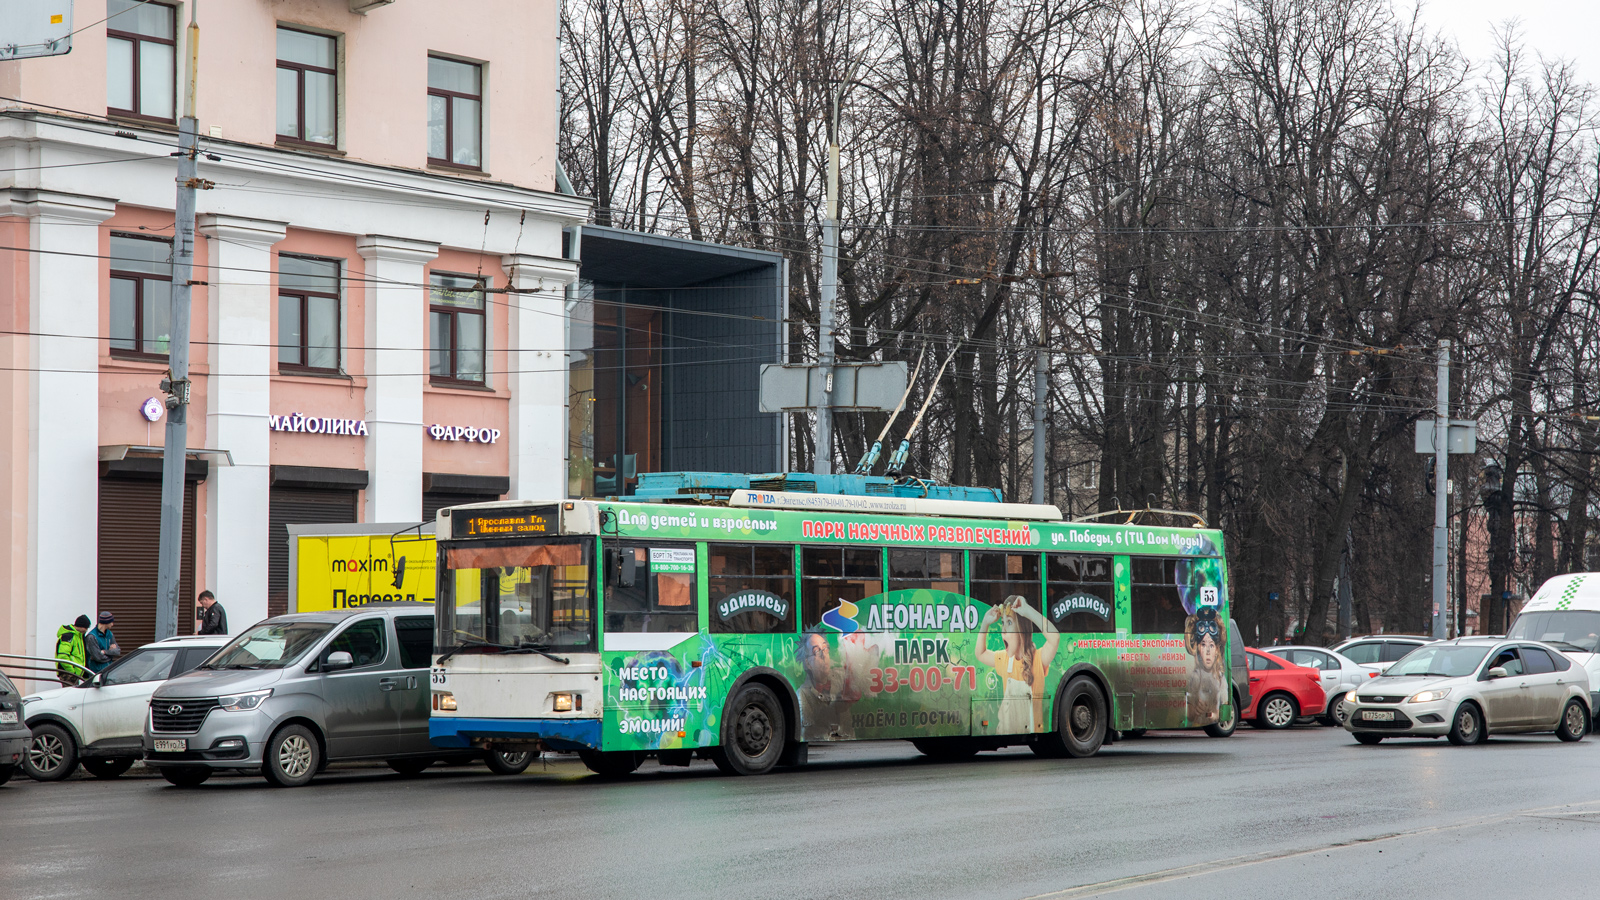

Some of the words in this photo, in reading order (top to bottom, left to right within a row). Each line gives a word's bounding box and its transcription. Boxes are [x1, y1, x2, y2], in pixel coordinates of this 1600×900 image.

[269, 413, 369, 436] МАЙОЛИКА
[429, 424, 500, 444] ФАРФОР
[469, 518, 476, 535] 1
[477, 517, 526, 528] Ярославль
[530, 515, 547, 524] Гл.
[517, 523, 546, 533] завод
[618, 509, 647, 525] Для
[651, 512, 697, 530] детей
[701, 516, 709, 528] и
[712, 517, 778, 533] взрослых
[802, 520, 845, 538] ПАРК
[848, 522, 924, 541] НАУЧНЫХ
[928, 525, 1033, 545] РАЗВЛЕЧЕНИЙ
[1051, 531, 1067, 545] ул.
[1069, 529, 1114, 546] Победы,
[1115, 531, 1122, 544] 6
[1124, 530, 1145, 546] (ТЦ
[1147, 532, 1169, 546] Дом
[1171, 532, 1203, 549] Моды)
[720, 594, 787, 616] УДИВИСЬ!
[1204, 590, 1215, 603] 53
[1053, 596, 1109, 618] ЗАРЯДИСЬ!
[867, 604, 979, 632] ЛЕОНАРДО
[894, 638, 951, 665] ПАРК
[1077, 639, 1140, 649] ИНТЕРАКТИВНЫЕ
[1142, 639, 1186, 649] ЭКСПОНАТЫ
[1121, 653, 1150, 662] КВЕСТЫ
[1162, 653, 1186, 662] КВИЗЫ
[432, 668, 446, 684] 53
[619, 666, 668, 680] МЕСТО
[869, 666, 977, 693] 33-00-71
[1130, 667, 1146, 675] ДНИ
[1147, 666, 1187, 675] РОЖДЕНИЯ
[1171, 679, 1187, 688] ШОУ
[619, 686, 707, 702] НАСТОЯЩИХ
[619, 713, 685, 734] ЭМОЦИЙ!
[852, 708, 896, 729] ЖДЁМ
[898, 712, 907, 727] В
[911, 711, 960, 726] ГОСТИ!
